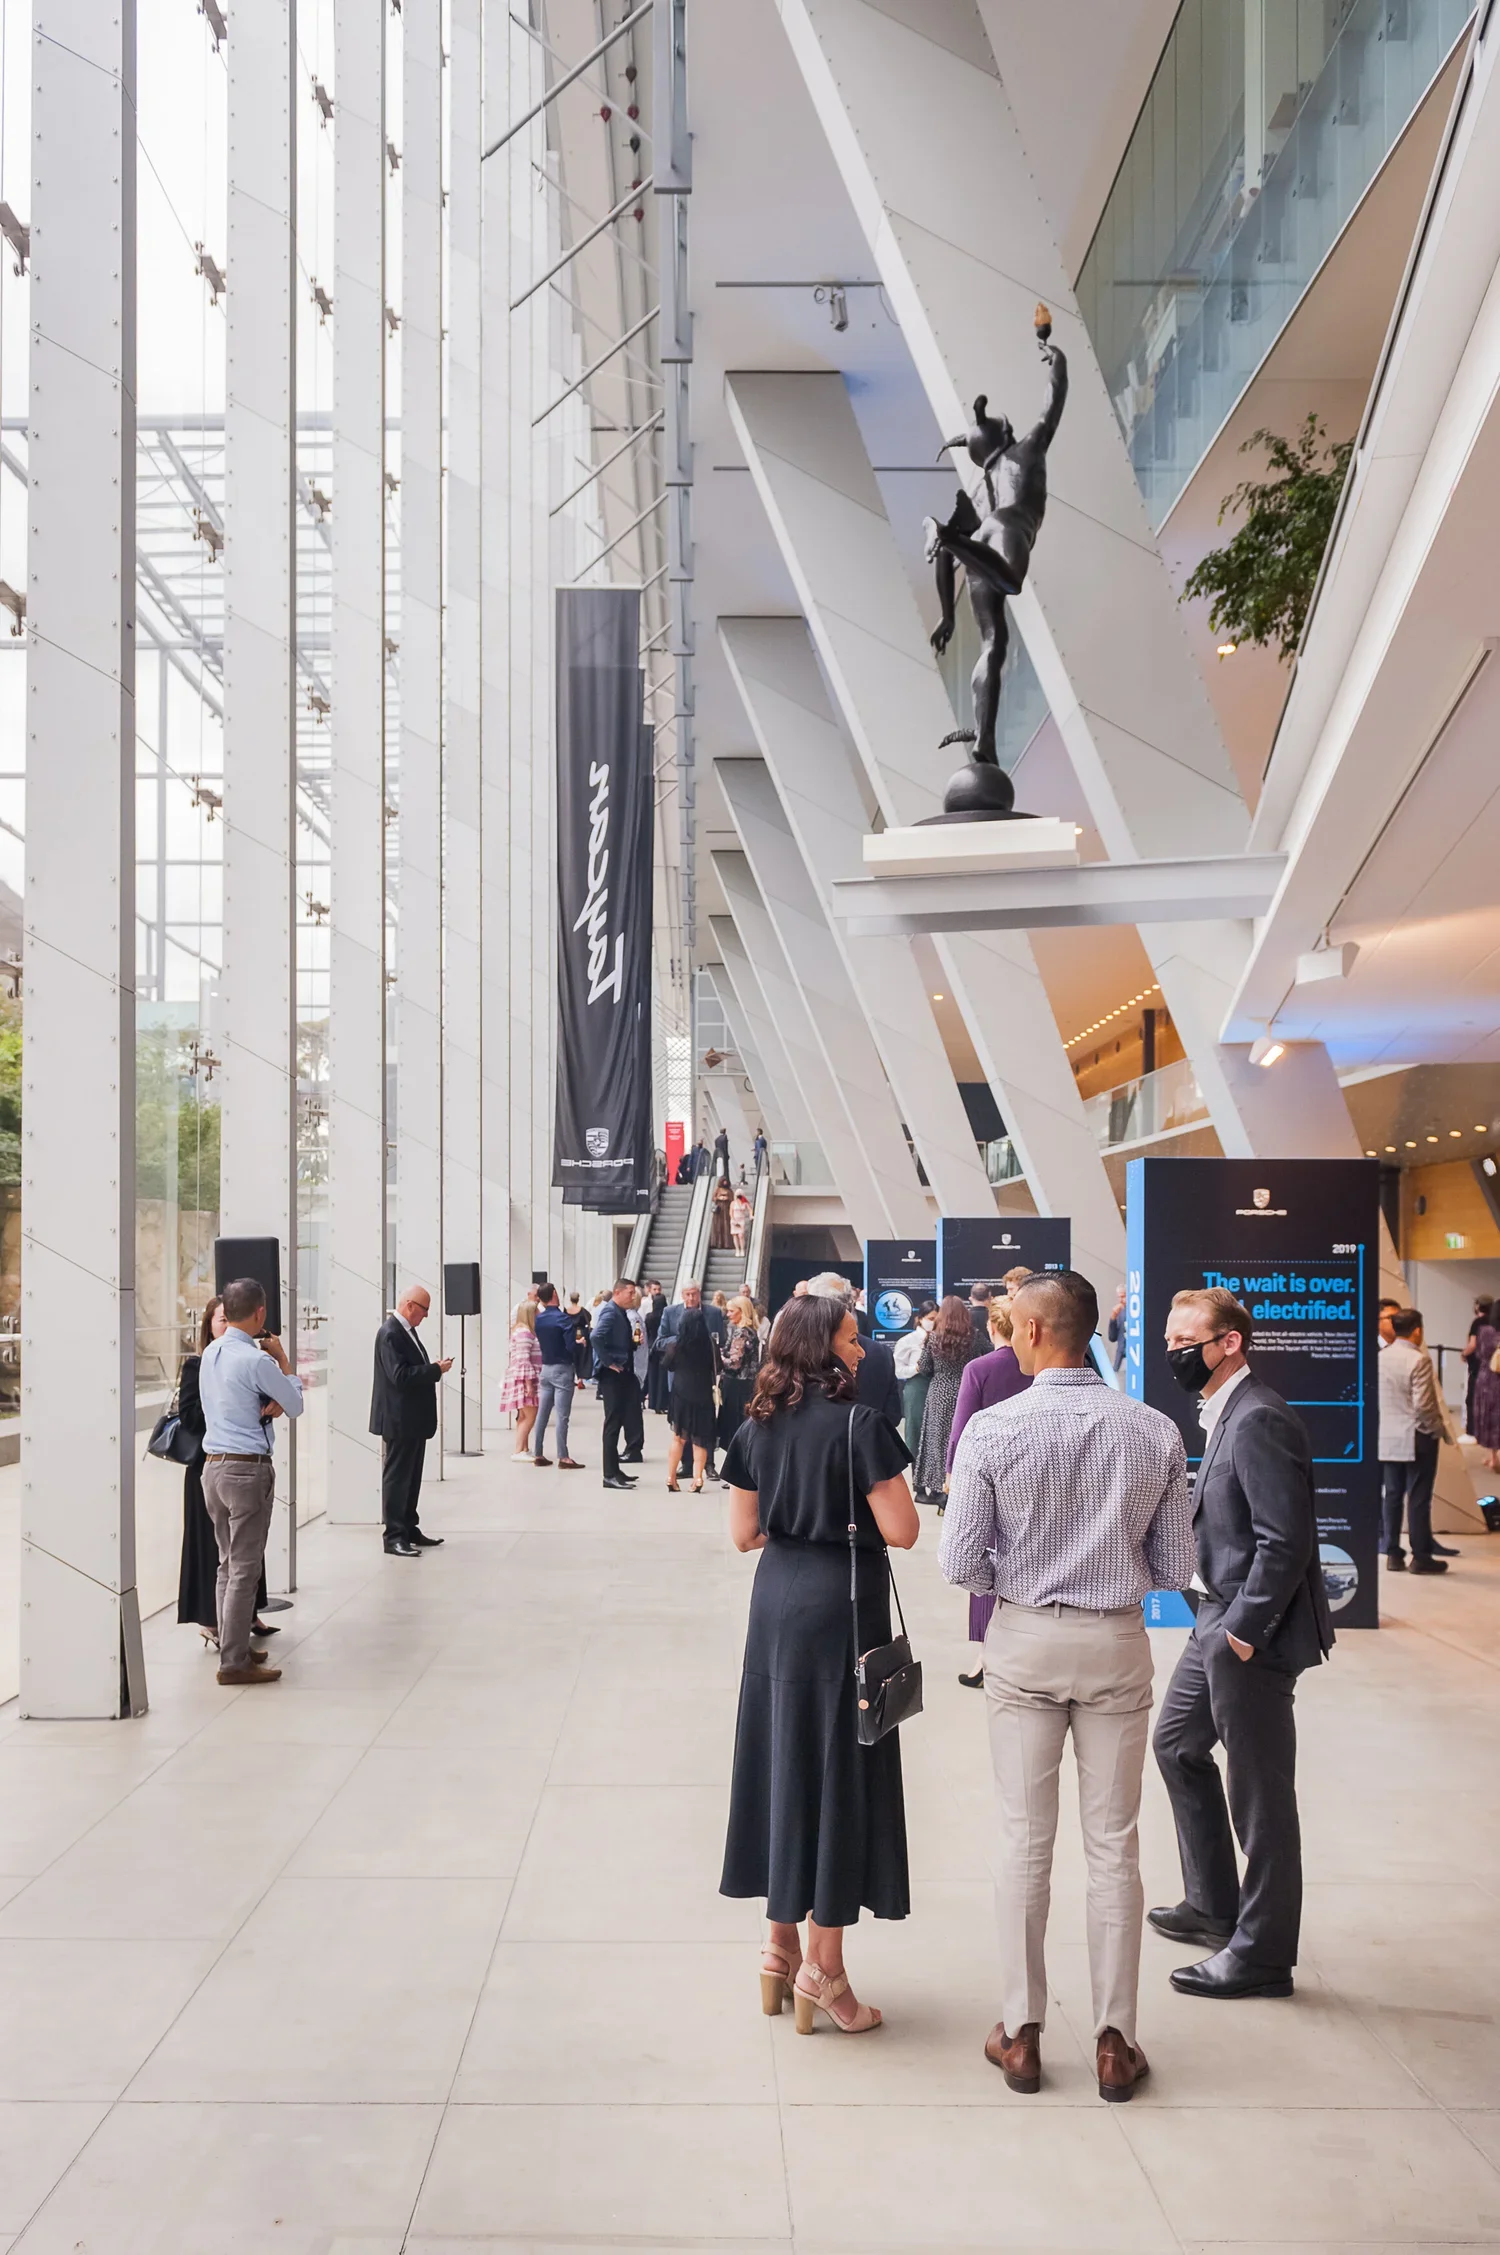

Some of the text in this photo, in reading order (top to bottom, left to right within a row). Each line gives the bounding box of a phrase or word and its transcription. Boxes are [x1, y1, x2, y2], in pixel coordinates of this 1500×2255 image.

[1332, 1244, 1357, 1254] 2019
[1203, 1272, 1356, 1293] The wait is over.
[1129, 1270, 1141, 1367] 2017
[1252, 1300, 1356, 1320] electrified.
[1151, 1598, 1161, 1620] 2017
